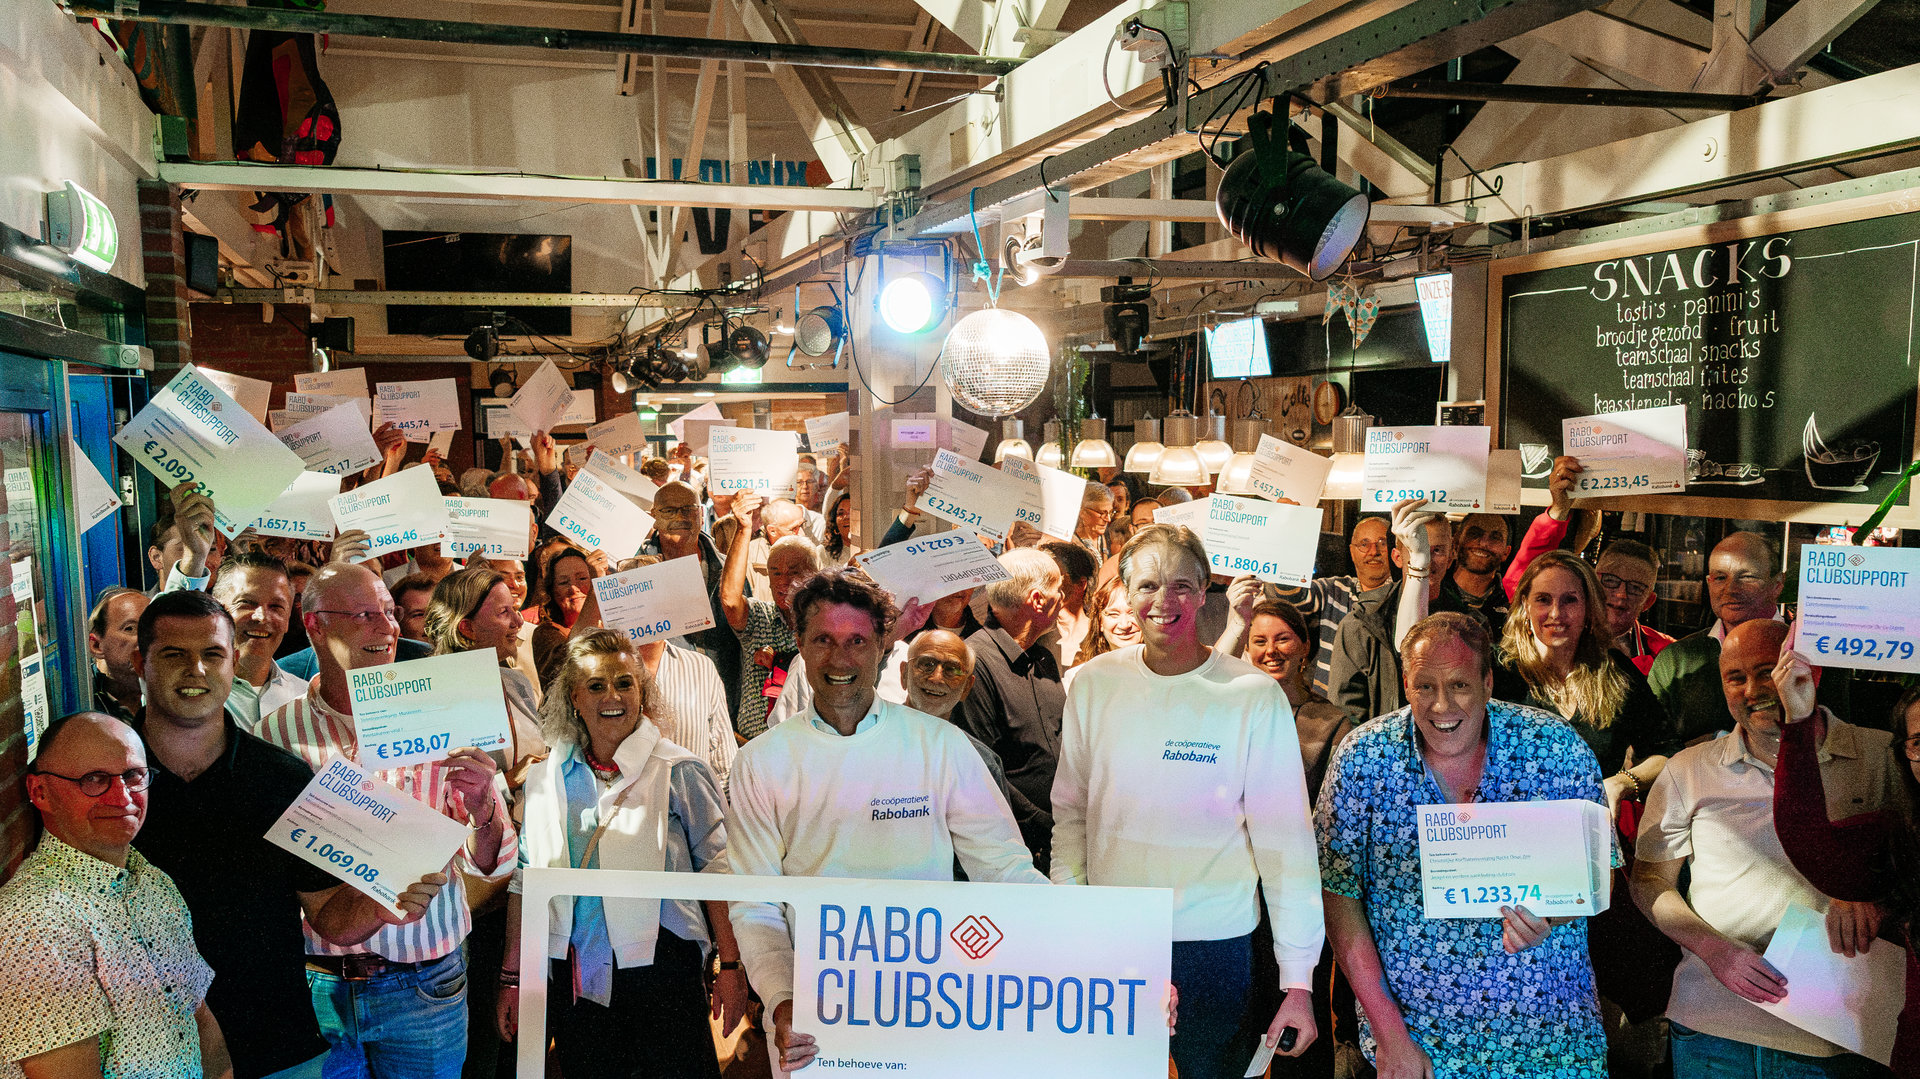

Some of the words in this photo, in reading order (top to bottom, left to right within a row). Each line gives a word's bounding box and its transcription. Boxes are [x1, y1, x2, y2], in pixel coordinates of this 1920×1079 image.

[1590, 238, 1791, 301] SNACKS
[1617, 301, 1666, 323] tosti's
[1683, 288, 1760, 328] panini's
[1596, 322, 1647, 348] broodje
[1650, 316, 1702, 349] gezond
[1730, 310, 1779, 336] fruit
[1616, 342, 1692, 366] teamschaal
[1699, 339, 1760, 362] snacks
[1622, 365, 1694, 389] teamschaal
[187, 380, 214, 406] RABO
[379, 385, 395, 393] RABO
[380, 391, 421, 400] CLUBSUPPORT
[289, 395, 307, 403] RABO
[1702, 387, 1775, 410] nachos
[177, 391, 239, 445] CLUBSUPPORT
[398, 420, 430, 430] 445,74
[713, 435, 729, 443] RABO
[1370, 431, 1393, 442] RABO
[1570, 426, 1592, 438] RABO
[1570, 433, 1628, 448] CLUBSUPPORT
[712, 443, 756, 453] CLUBSUPPORT
[1369, 442, 1431, 454] CLUBSUPPORT
[593, 451, 609, 466] RABO
[938, 452, 958, 466] RABO
[1005, 458, 1023, 469] RABO
[1258, 449, 1293, 466] CLUBSUPPORT
[152, 447, 214, 498] 2.09231
[590, 458, 627, 482] CLUBSUPPORT
[935, 460, 983, 484] CLUBSUPPORT
[1003, 466, 1046, 486] CLUBSUPPORT
[578, 473, 596, 488] RABO
[728, 479, 769, 489] 2.821,51
[1259, 481, 1284, 498] 457,50
[1591, 475, 1649, 490] 2.233,45
[337, 494, 357, 506] RABO
[339, 494, 391, 516] CLUBSUPPORT
[445, 499, 463, 509] RABO
[573, 482, 616, 512] CLUBSUPPORT
[1212, 498, 1235, 511] RABO
[1386, 490, 1447, 503] 2.93912
[936, 499, 983, 527] 2.245,21
[1210, 509, 1268, 527] CLUBSUPPORT
[257, 517, 306, 532] 1.657,15
[566, 520, 601, 547] 304,60
[367, 528, 418, 549] 1.986,46
[906, 538, 954, 556] 622,16
[459, 543, 503, 554] 1.904,13
[1223, 555, 1278, 575] 1.880,61
[1808, 551, 1846, 567] RABO
[941, 564, 1001, 583] CLUBSUPPORT
[981, 571, 1007, 583] RABO
[1807, 568, 1909, 587] CLUBSUPPORT
[597, 577, 619, 592] RABO
[599, 580, 654, 602] CLUBSUPPORT
[628, 620, 671, 640] 304,60
[1834, 637, 1915, 661] 492,79
[352, 671, 383, 688] RABO
[355, 677, 432, 703] CLUBSUPPORT
[392, 732, 451, 758] 528,07
[1165, 739, 1174, 747] de
[1174, 740, 1221, 750] coöperatieve
[1162, 749, 1218, 764] Rabobank
[328, 760, 363, 786] RABO
[319, 773, 398, 824] CLUBSUPPORT
[870, 797, 881, 806] de
[881, 795, 929, 806] coöperatieve
[871, 805, 930, 821] Rabobank
[1425, 811, 1456, 827] RABO
[1426, 824, 1508, 842] CLUBSUPPORT
[304, 834, 380, 883] 1.069,08
[370, 885, 396, 905] Rabobank
[1461, 884, 1542, 905] 1.233,74
[818, 904, 943, 965] RABO
[816, 967, 1147, 1036] CLUBSUPPORT
[817, 1058, 835, 1068] Ten
[837, 1058, 883, 1070] behoeve
[885, 1062, 907, 1071] van:
